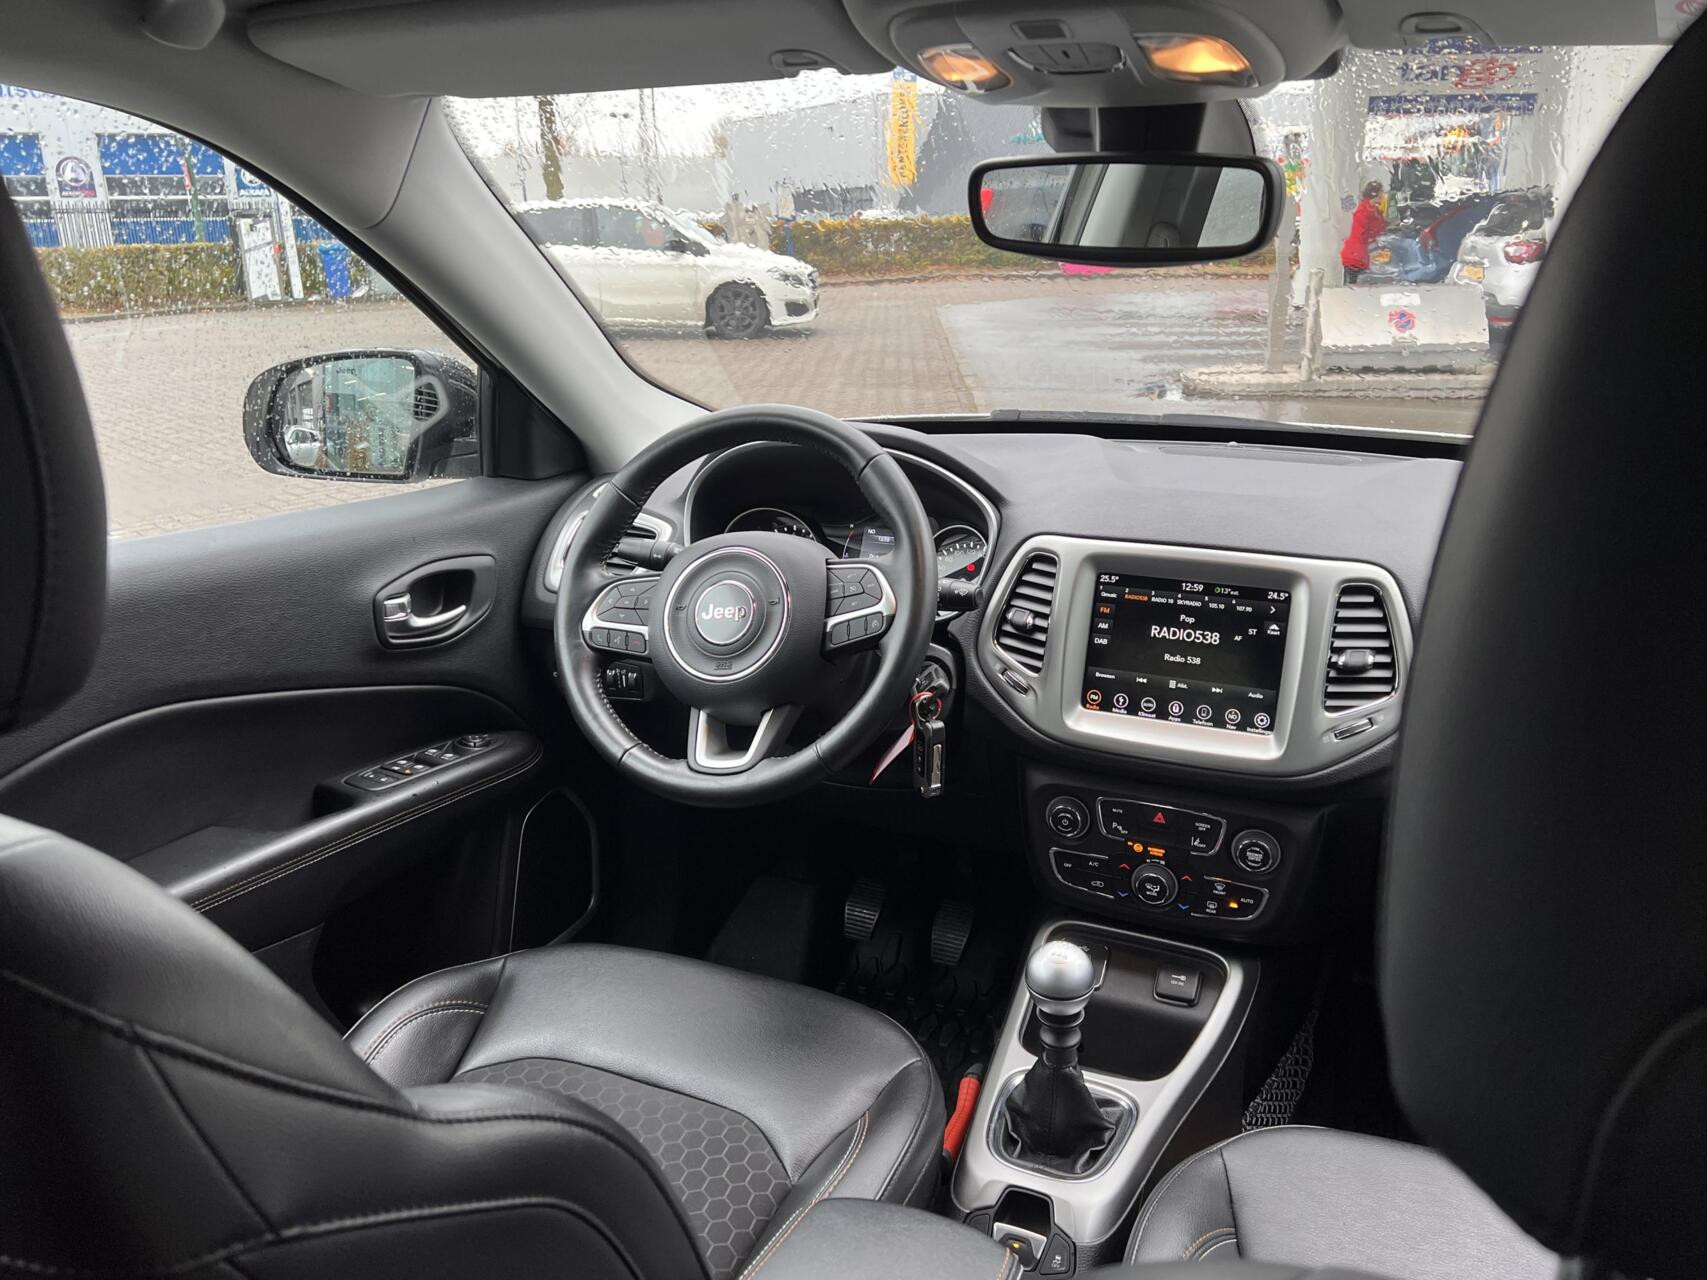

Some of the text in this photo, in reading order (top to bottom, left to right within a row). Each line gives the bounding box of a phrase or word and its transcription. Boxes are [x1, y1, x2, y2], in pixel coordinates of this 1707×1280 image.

[1181, 582, 1204, 592] 12:59
[1151, 596, 1167, 604] RADIO
[702, 603, 747, 622] Jeep
[1180, 614, 1195, 624] Pop
[1150, 625, 1220, 645] RADIO538
[1248, 628, 1258, 636] ST
[1094, 637, 1108, 645] DAB
[1164, 653, 1202, 665] Radio 538
